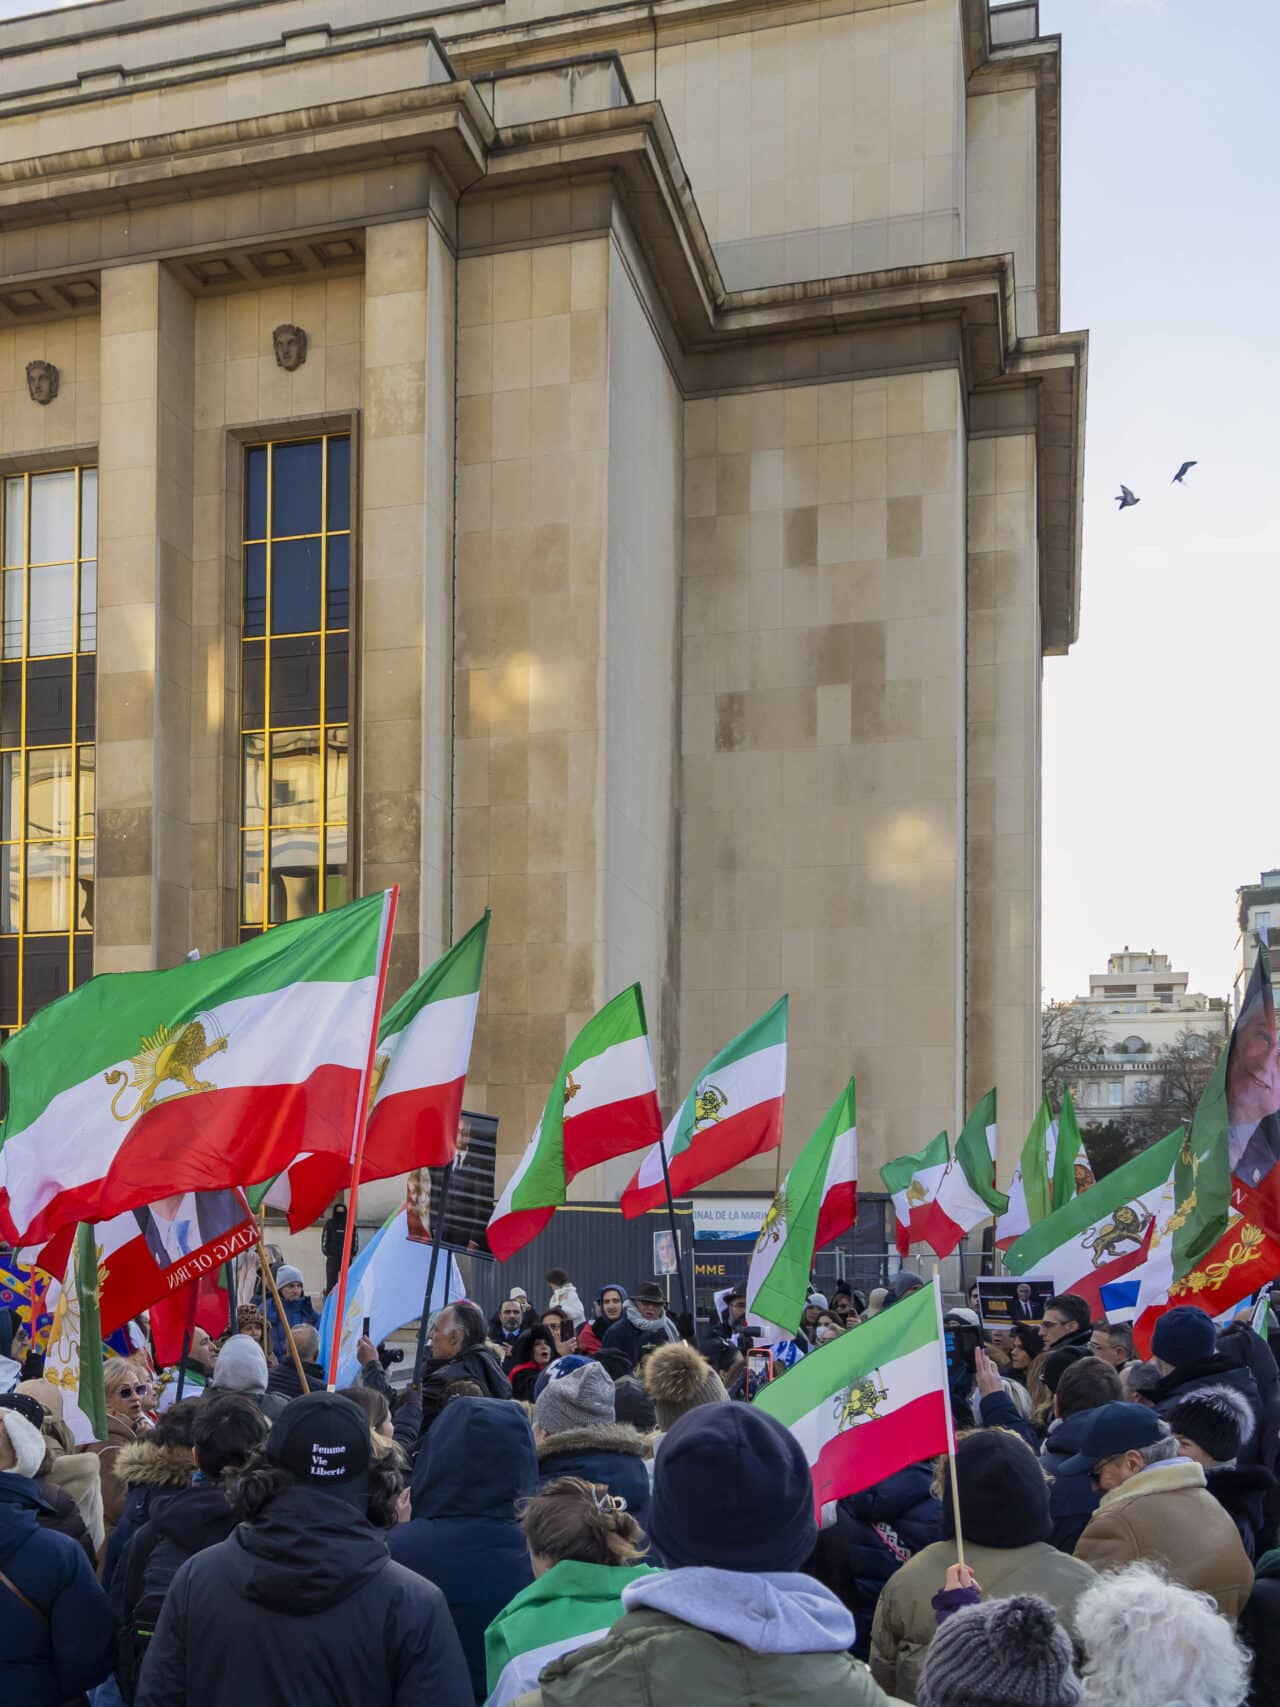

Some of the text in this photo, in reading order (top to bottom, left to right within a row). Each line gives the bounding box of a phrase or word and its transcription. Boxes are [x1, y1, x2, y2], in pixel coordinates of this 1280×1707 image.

[715, 1210, 727, 1220] DE
[728, 1210, 739, 1220] LA
[312, 1443, 346, 1454] Femme
[312, 1455, 328, 1465] Vie
[311, 1466, 346, 1475] Liberté
